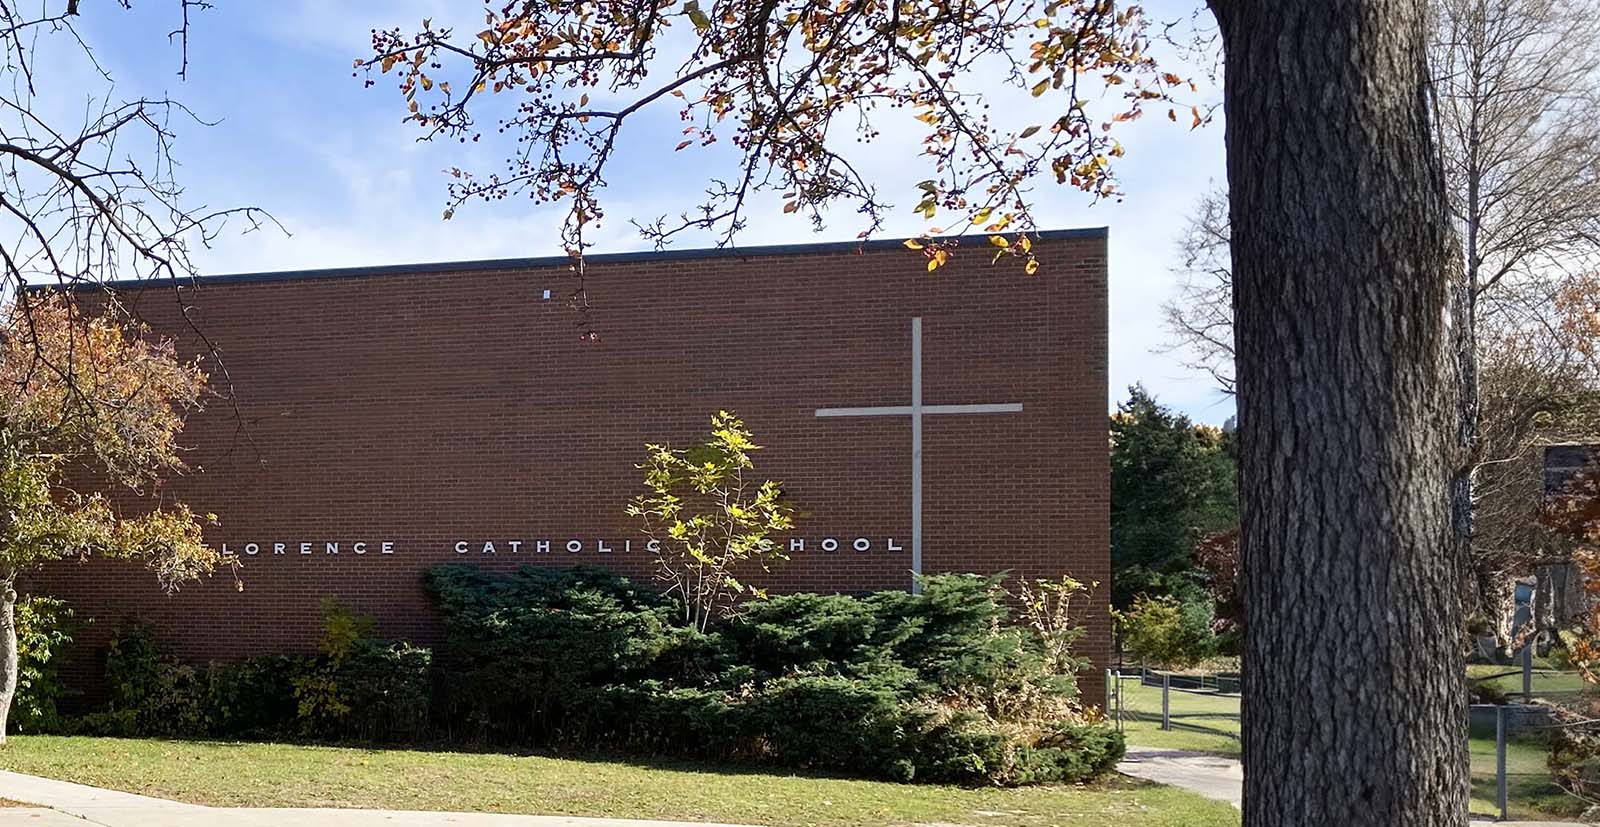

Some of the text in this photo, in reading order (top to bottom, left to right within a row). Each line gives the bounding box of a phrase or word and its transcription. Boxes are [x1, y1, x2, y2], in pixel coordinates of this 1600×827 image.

[199, 537, 903, 555] LORENCE CATHOLIC CHOOL
